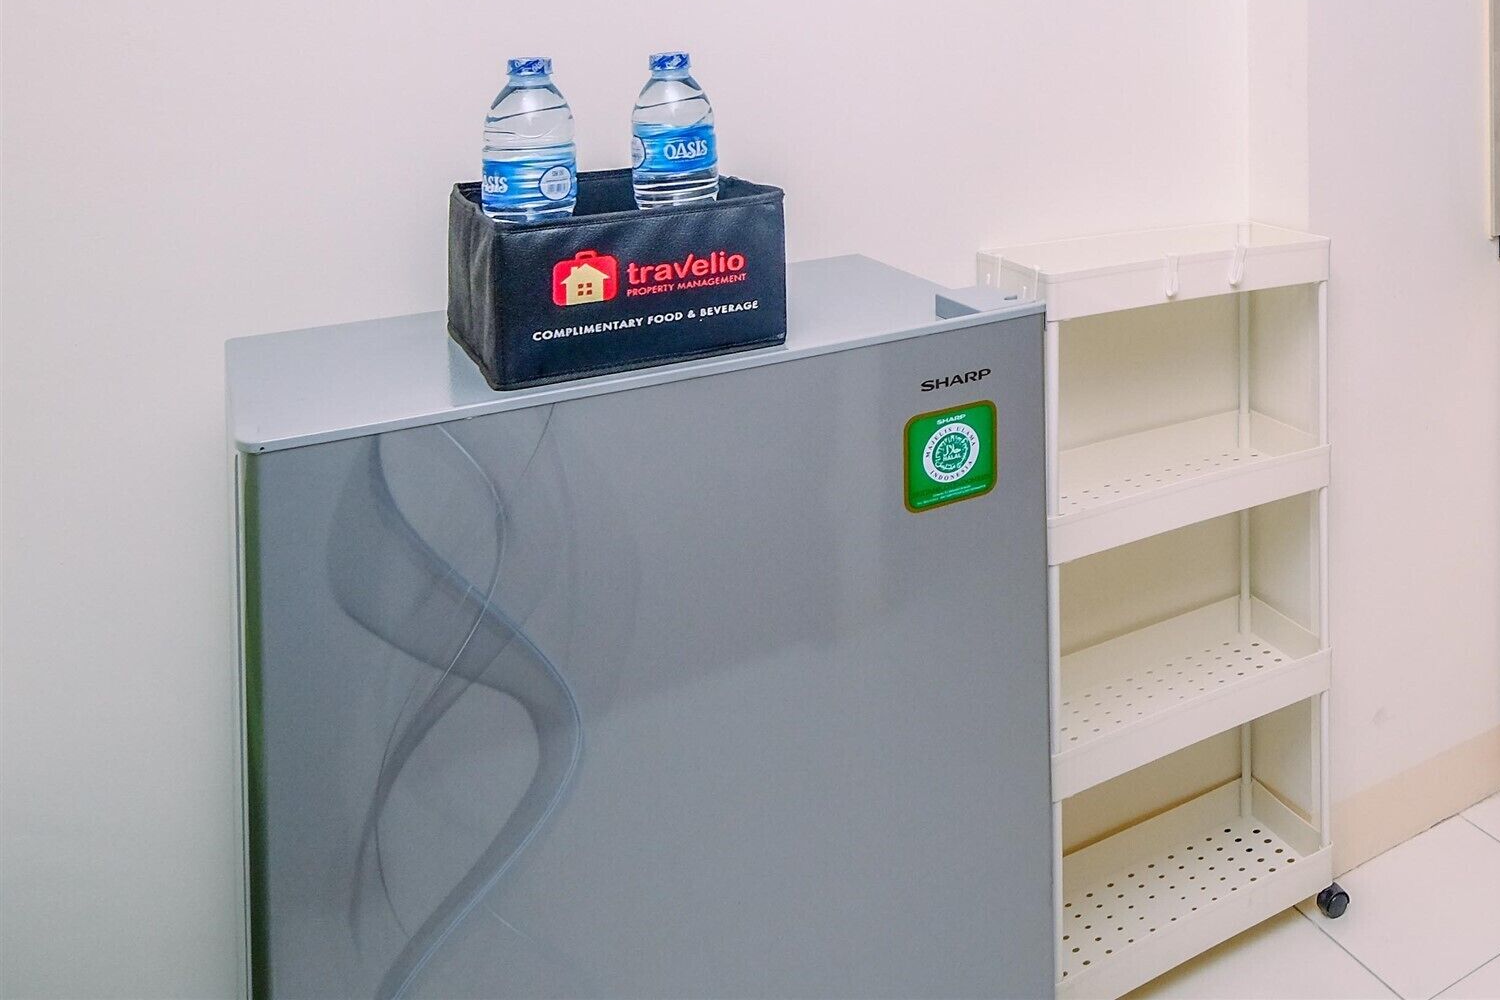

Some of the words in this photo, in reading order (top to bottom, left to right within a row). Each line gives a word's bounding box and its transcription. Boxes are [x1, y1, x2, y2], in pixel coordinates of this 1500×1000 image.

[663, 138, 708, 161] OASIS
[627, 283, 675, 297] PROPERTY
[677, 272, 747, 290] MANAGEMENT
[532, 317, 644, 341] COMPLIMENTARY
[647, 311, 684, 325] FOOD
[687, 309, 696, 319] &
[700, 300, 759, 317] BEVERAGE
[920, 368, 992, 392] SHARP
[937, 414, 966, 425] SHARP
[930, 460, 973, 481] INDONESIA
